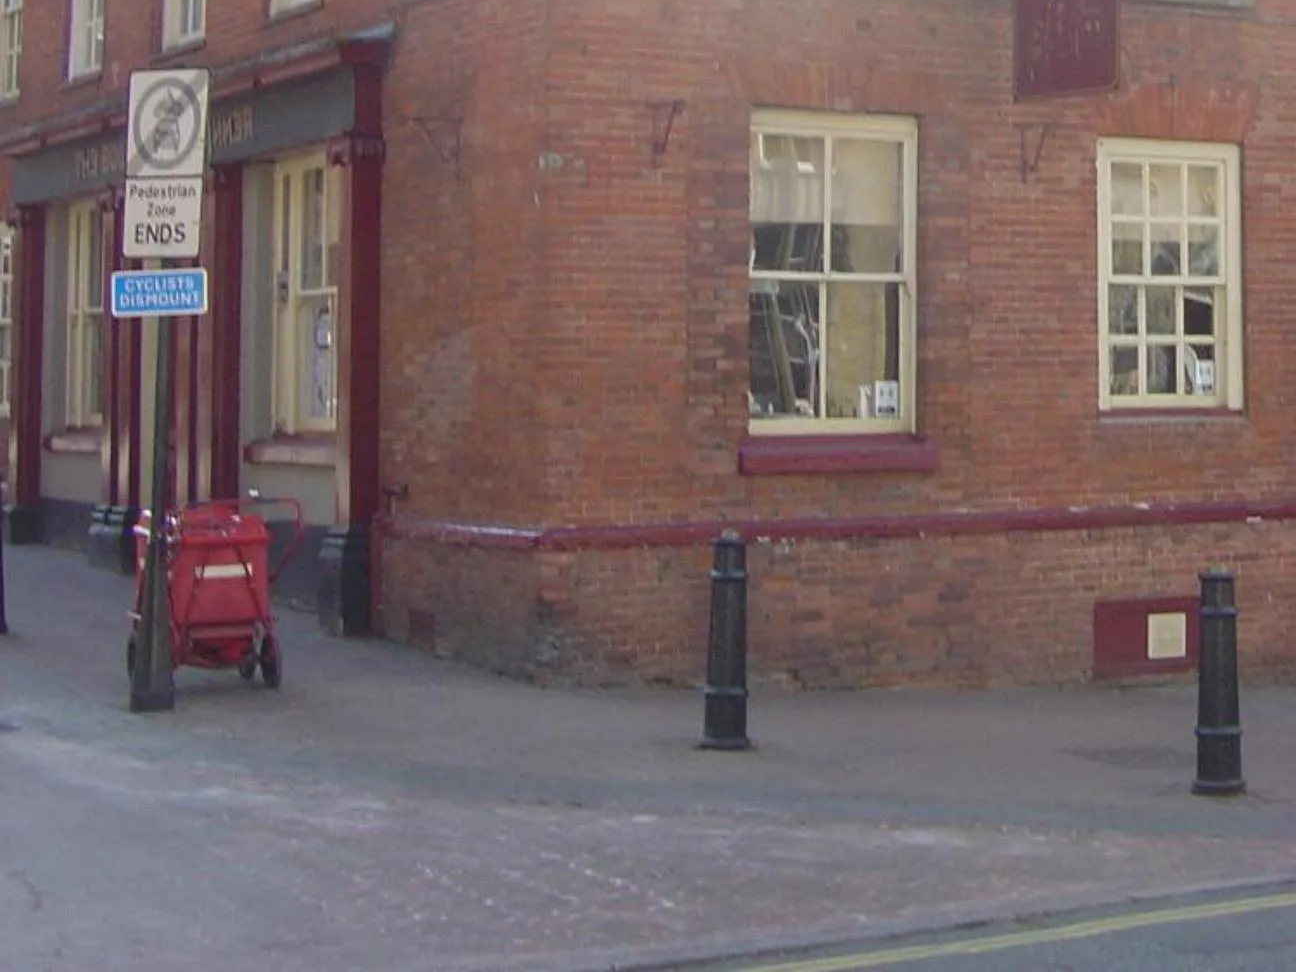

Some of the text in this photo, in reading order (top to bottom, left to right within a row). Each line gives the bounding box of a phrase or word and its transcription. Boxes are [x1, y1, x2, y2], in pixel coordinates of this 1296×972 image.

[129, 182, 197, 199] Pedestrian
[147, 201, 177, 217] Zone
[134, 222, 187, 245] ENDS
[124, 275, 195, 292] CYCLISTS
[120, 291, 199, 308] DISMOUNT
